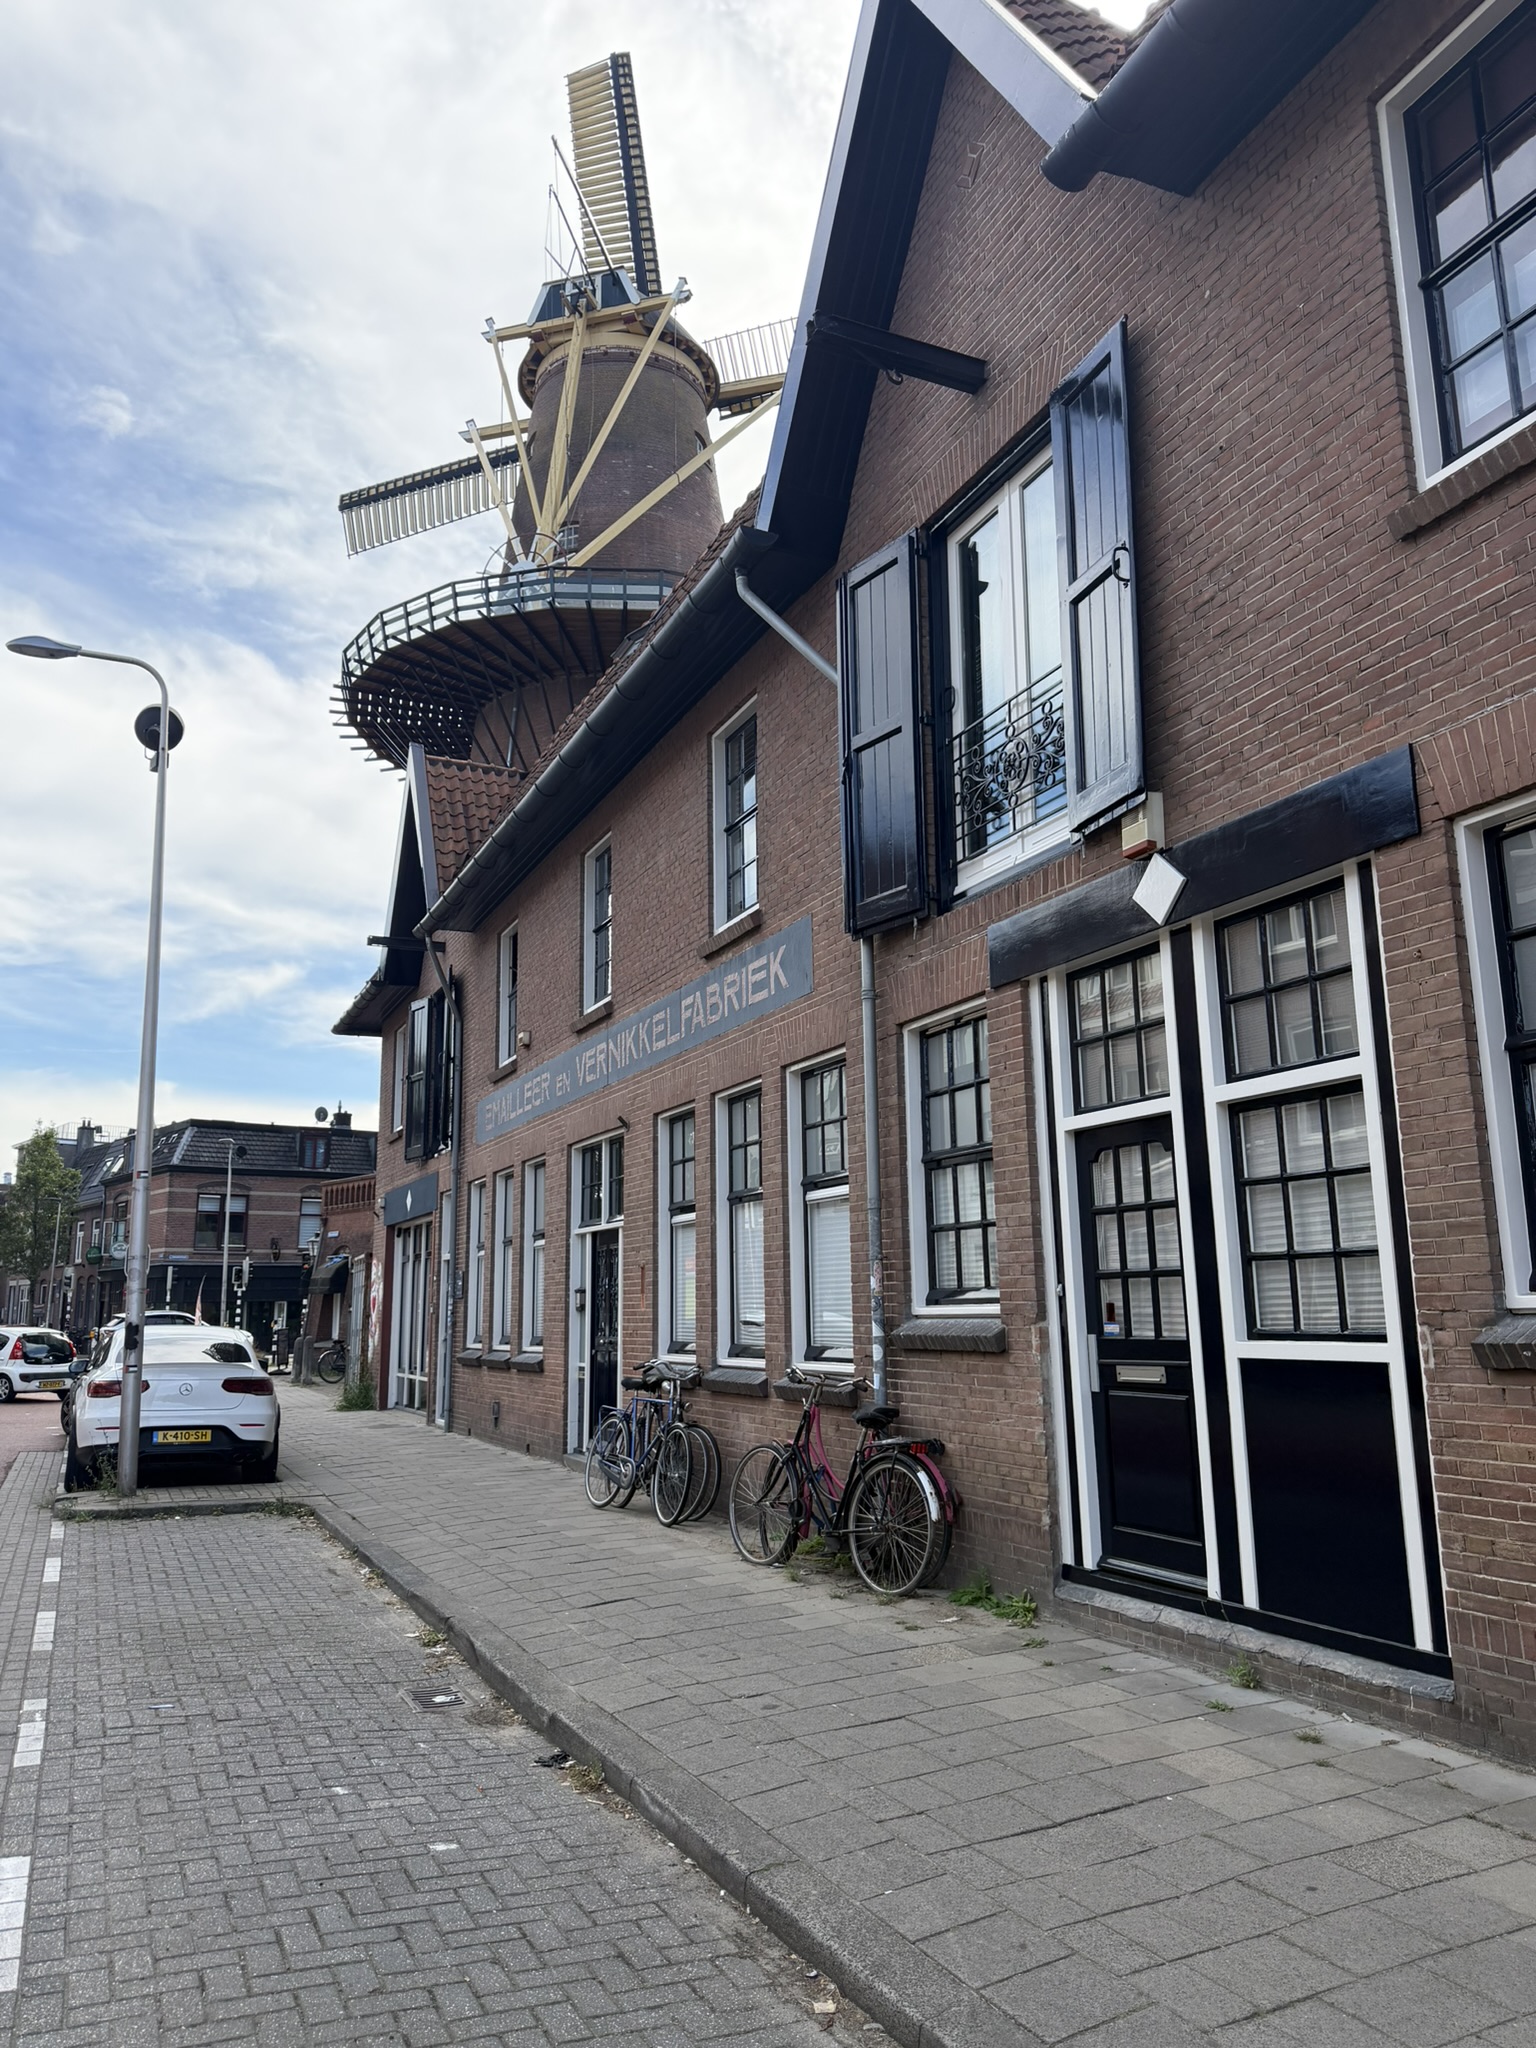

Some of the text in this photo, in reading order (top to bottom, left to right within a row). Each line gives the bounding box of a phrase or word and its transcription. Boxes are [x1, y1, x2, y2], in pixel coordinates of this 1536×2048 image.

[485, 944, 789, 1132] EMAILLEER EN VERNIKKELFABRIEK
[162, 1431, 208, 1441] K-410-SH
